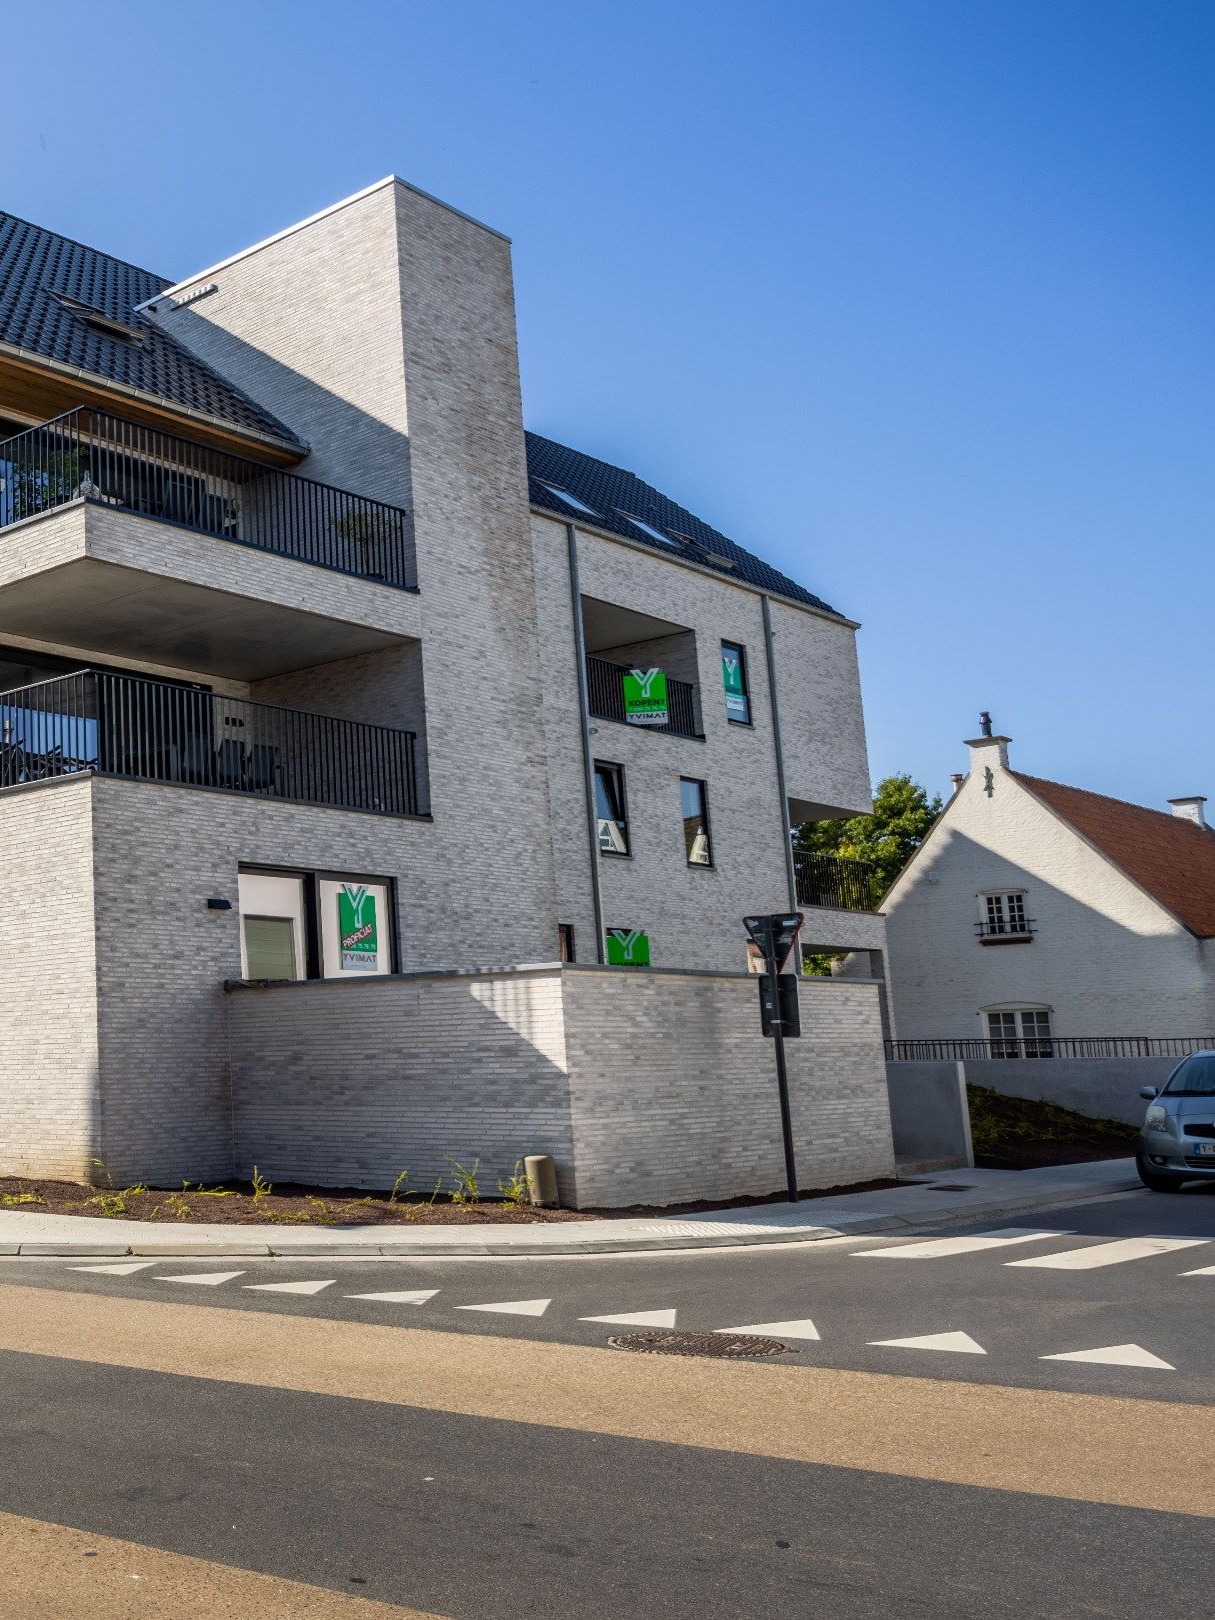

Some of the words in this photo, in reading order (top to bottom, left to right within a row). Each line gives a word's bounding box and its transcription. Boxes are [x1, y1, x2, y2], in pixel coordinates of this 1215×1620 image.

[629, 668, 660, 697] Y
[343, 884, 369, 928] Y
[342, 923, 373, 947] PROFICIAT
[343, 953, 376, 962] YVIMAT
